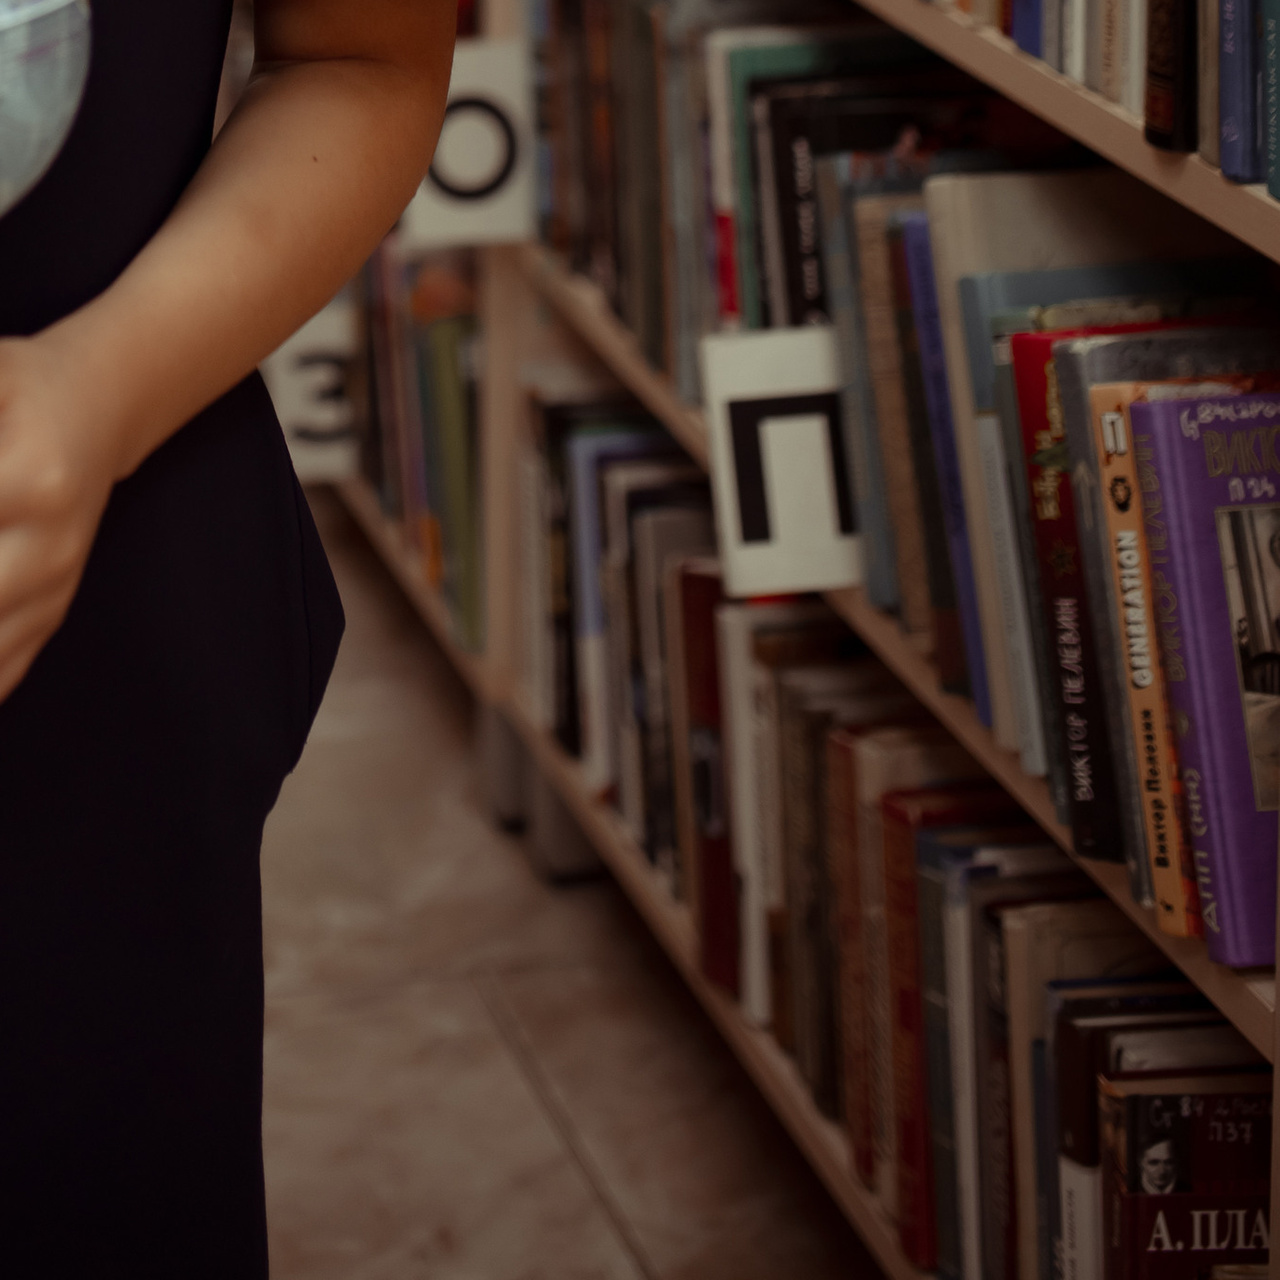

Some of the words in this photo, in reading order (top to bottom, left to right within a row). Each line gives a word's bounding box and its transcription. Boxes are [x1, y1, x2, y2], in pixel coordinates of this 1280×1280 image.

[428, 96, 516, 199] О
[729, 393, 857, 543] П
[1134, 433, 1168, 564] ПЕЛЕВИН
[1053, 597, 1086, 705] ПЕЛЕВИН
[1117, 529, 1153, 688] GENERATION
[1154, 569, 1187, 682] ВИКТОР
[1066, 712, 1094, 802] ВИКТОР
[1151, 799, 1170, 868] Виктор
[1146, 1209, 1185, 1252] А.
[1190, 1208, 1271, 1251] ПЛА
